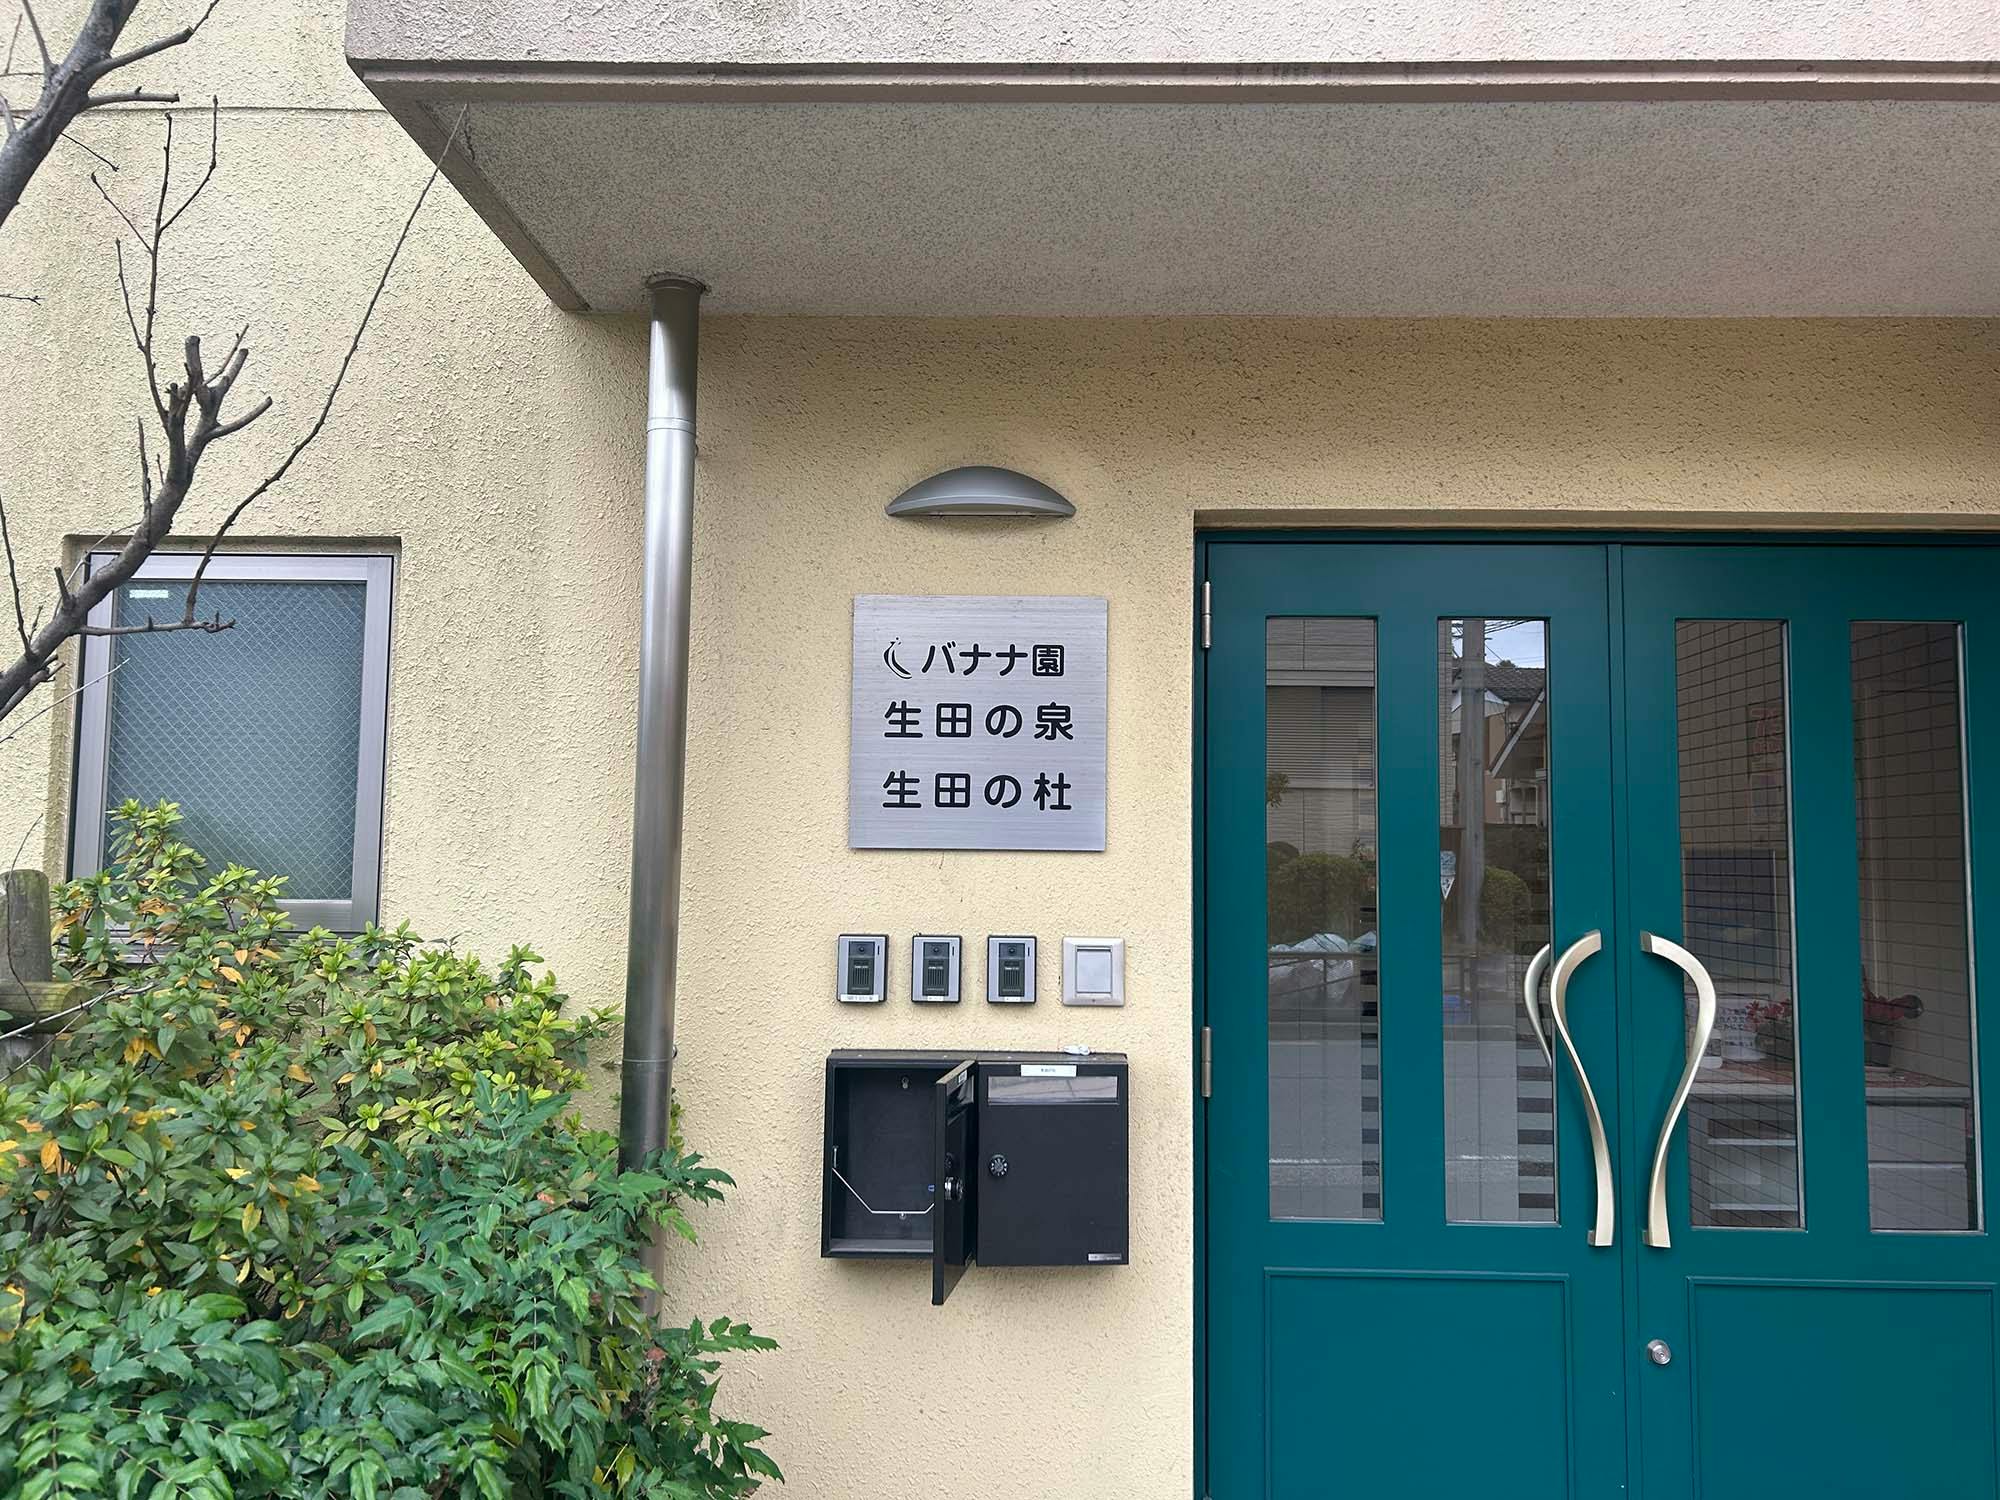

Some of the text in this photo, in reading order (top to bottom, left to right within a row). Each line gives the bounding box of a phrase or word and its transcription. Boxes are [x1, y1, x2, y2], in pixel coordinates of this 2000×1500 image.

[921, 641, 1065, 677] バナナ園
[884, 700, 1074, 740] 生田の泉
[882, 769, 1072, 811] 生田の杜
